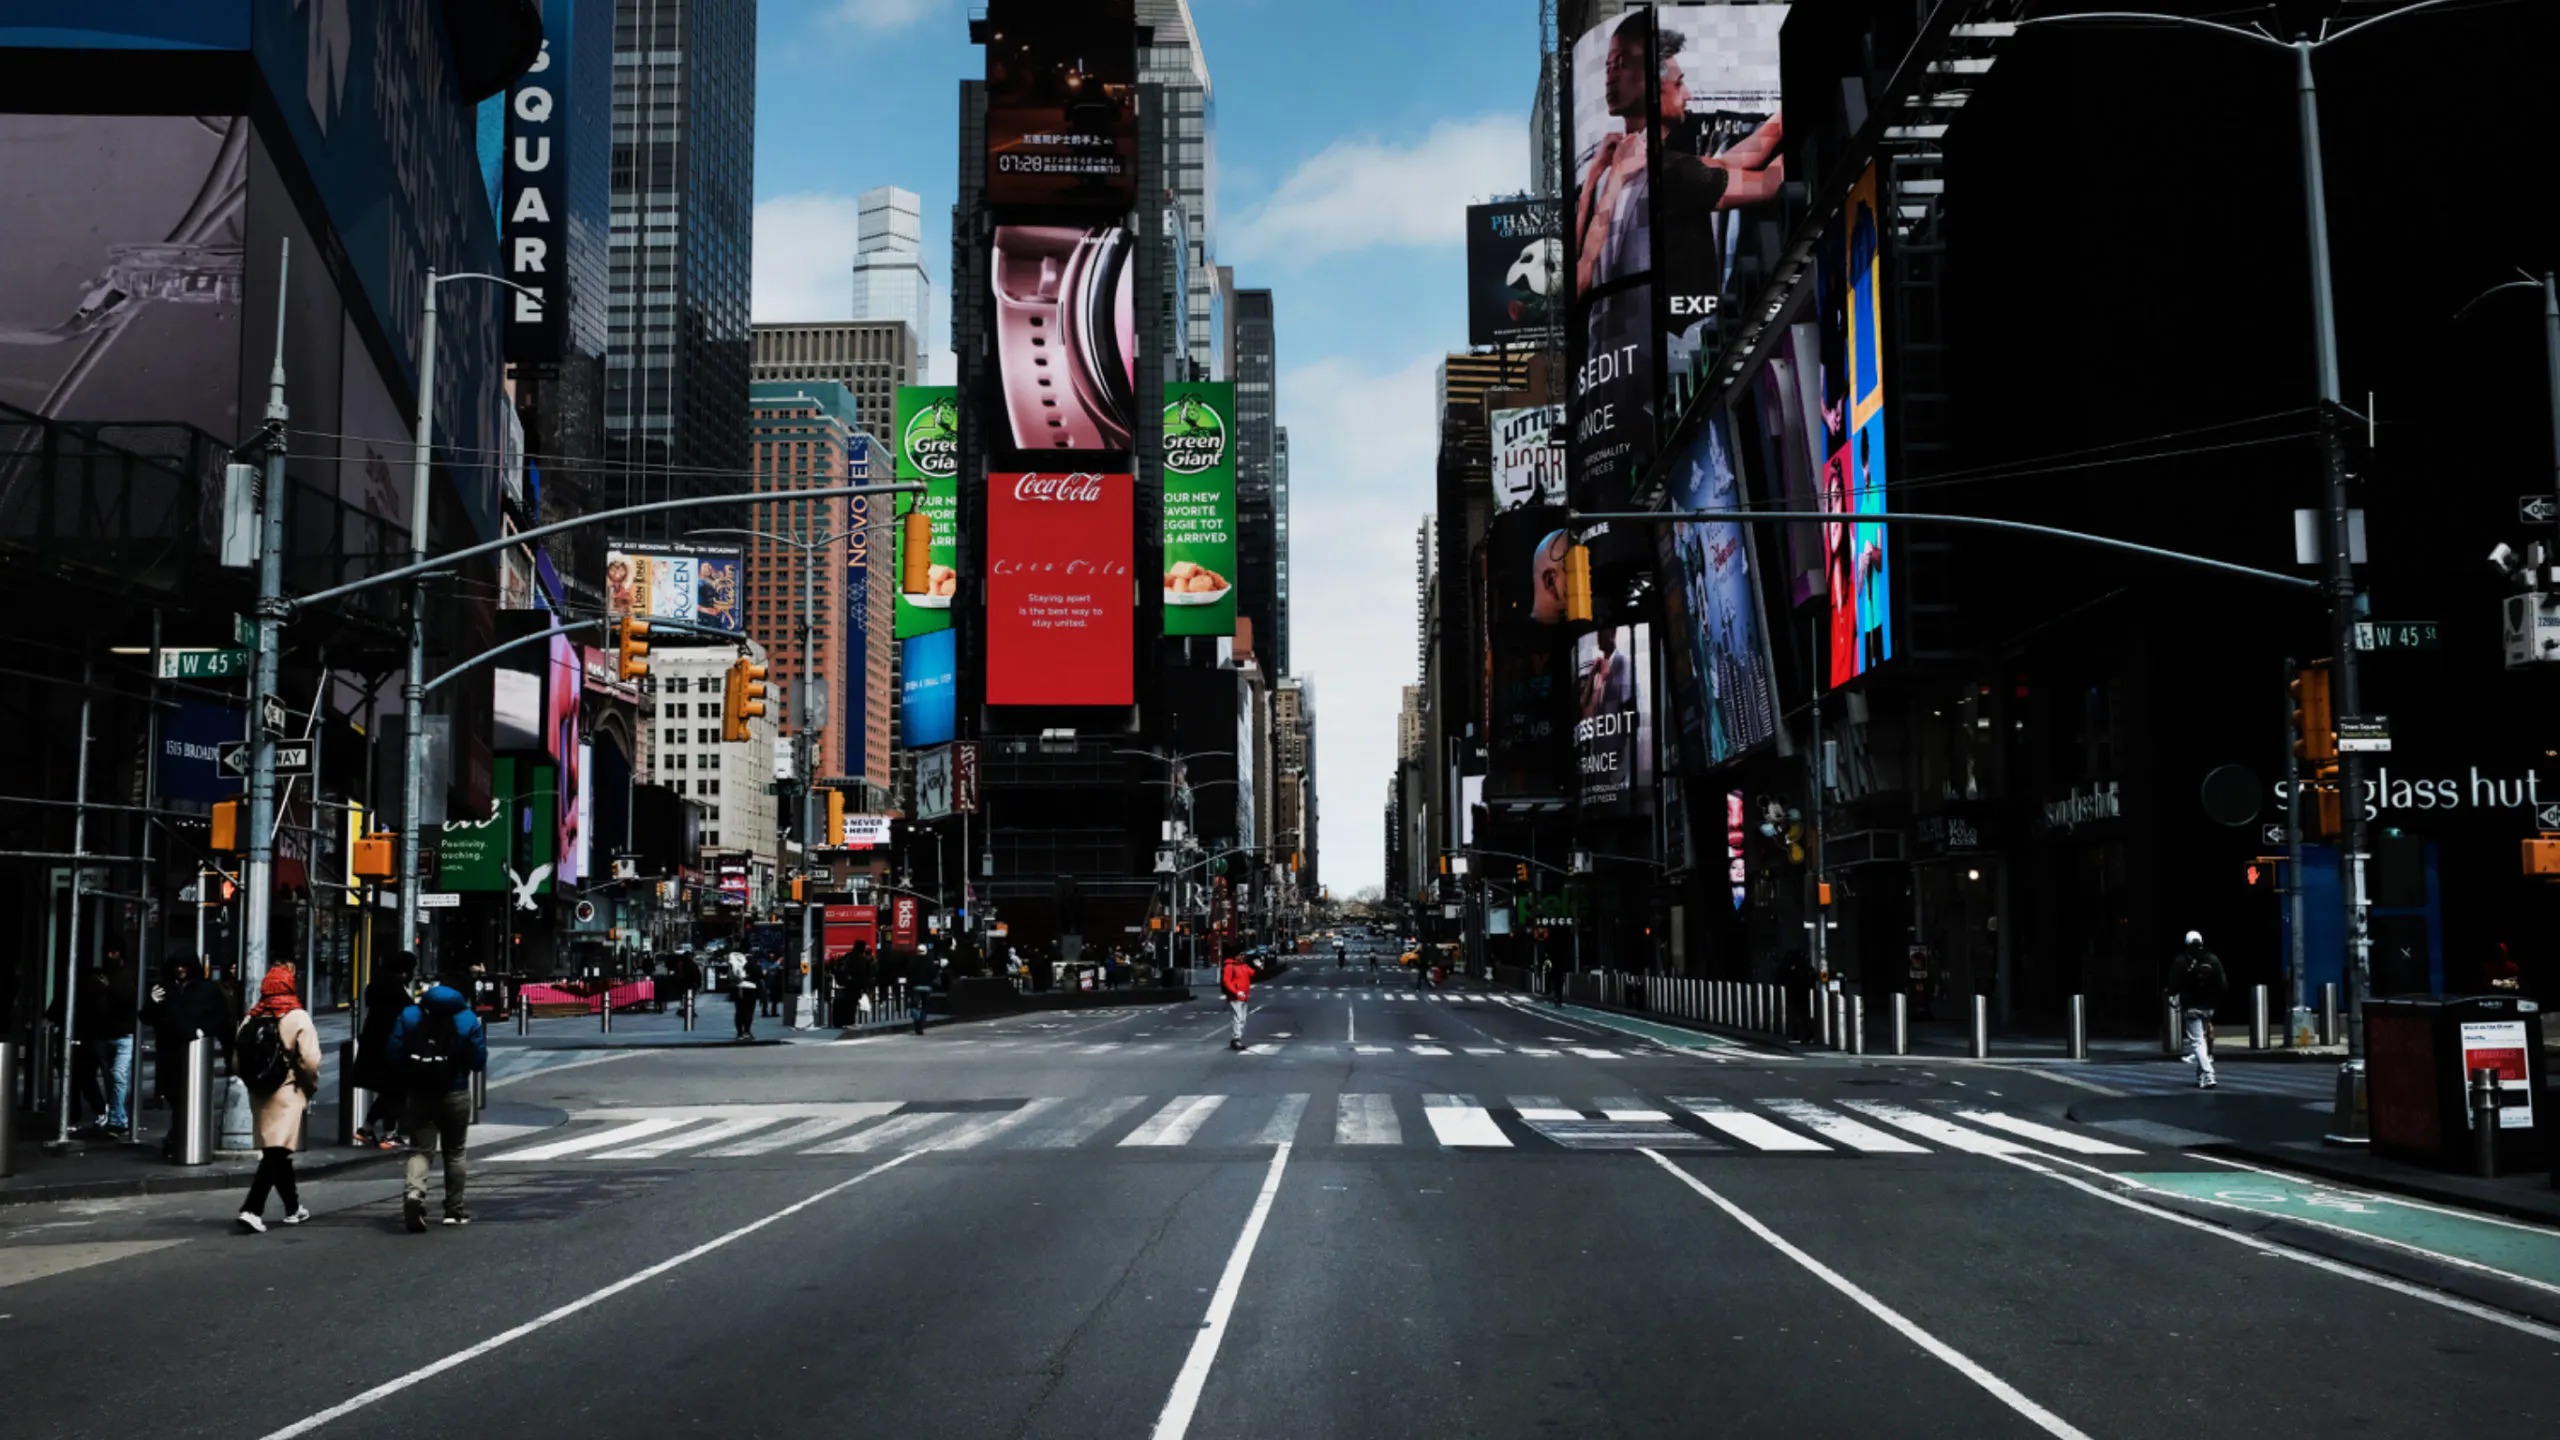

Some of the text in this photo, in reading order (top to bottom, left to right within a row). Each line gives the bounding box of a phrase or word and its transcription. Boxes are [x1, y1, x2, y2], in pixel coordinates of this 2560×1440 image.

[1000, 155, 1042, 171] 07:28
[914, 437, 957, 453] Gree
[1168, 451, 1222, 466] Giant
[1014, 472, 1104, 501] Coca-Cola
[1192, 493, 1220, 502] NEW
[849, 451, 869, 567] NOVOEL
[1201, 519, 1224, 529] TOT
[1176, 533, 1227, 544] ARRIVED
[673, 560, 690, 621] ROZEN
[1028, 593, 1091, 604] Staying apart
[1048, 607, 1068, 615] best
[1072, 610, 1089, 618] way
[1032, 620, 1052, 629] stay
[2376, 626, 2391, 647] W
[2400, 626, 2420, 647] 45
[182, 655, 200, 674] W
[208, 653, 228, 674] 45
[1596, 710, 1635, 737] EDIT
[2470, 765, 2543, 808] hut
[897, 900, 916, 928] tkts
